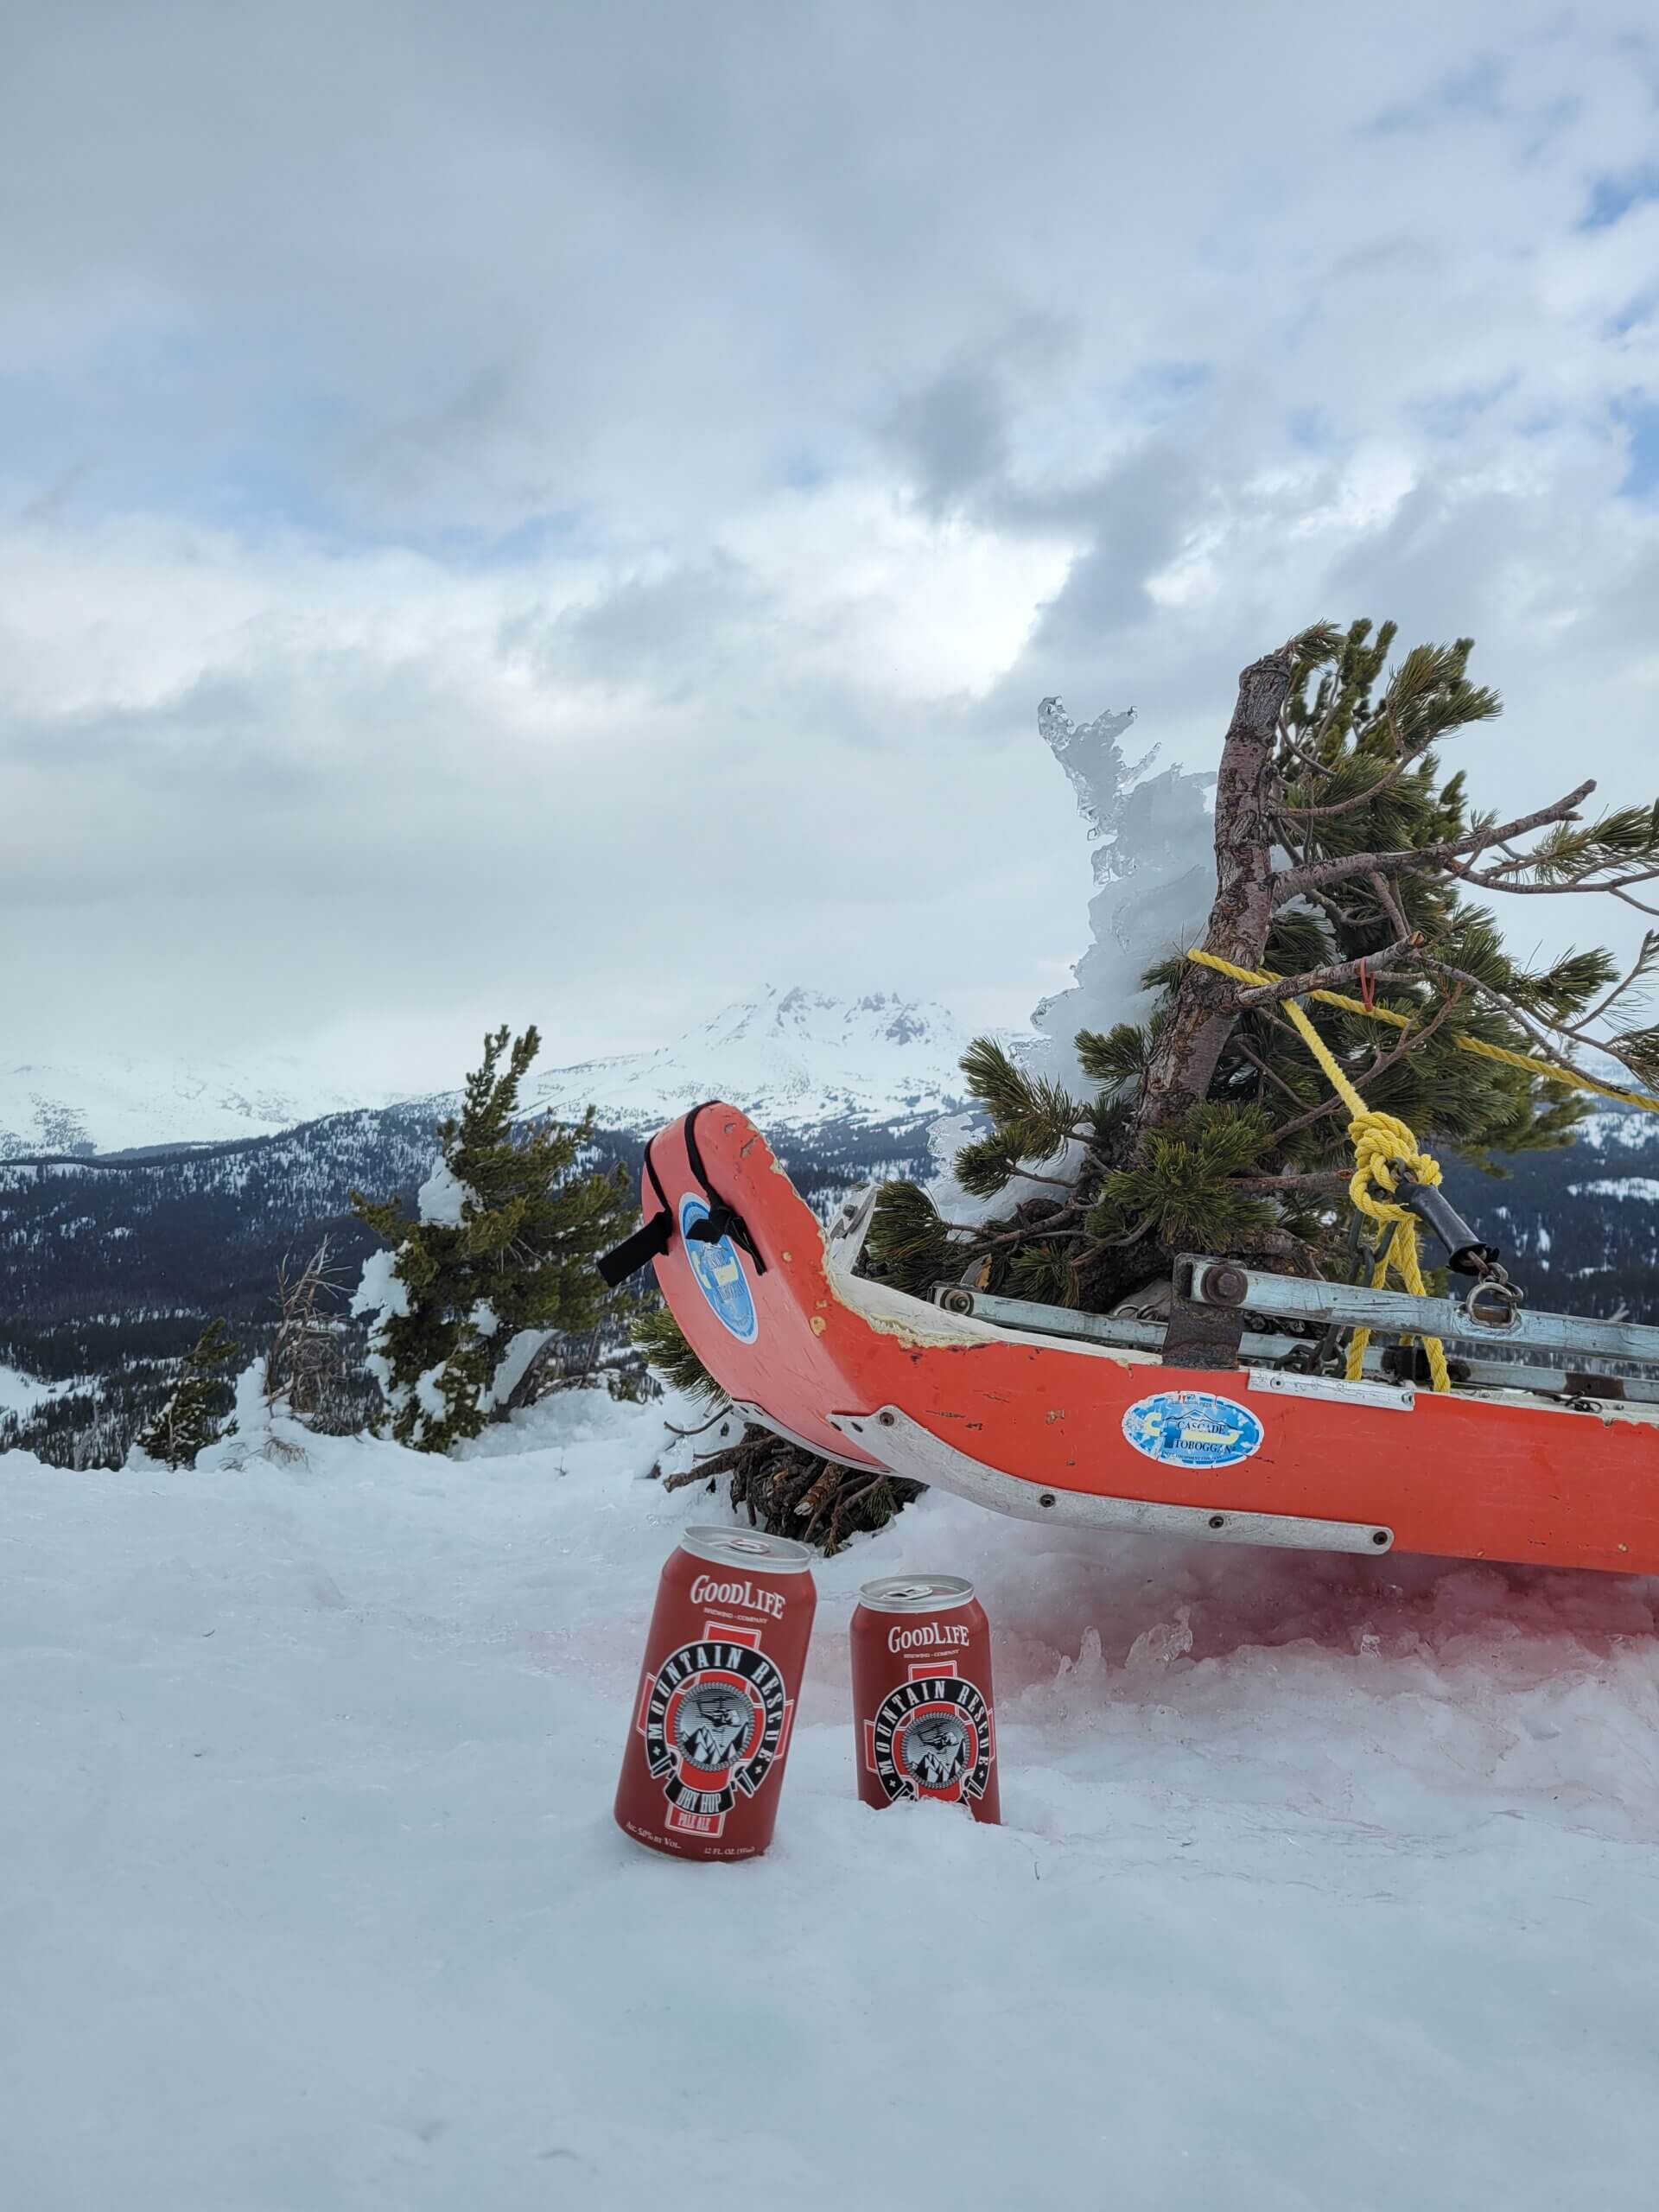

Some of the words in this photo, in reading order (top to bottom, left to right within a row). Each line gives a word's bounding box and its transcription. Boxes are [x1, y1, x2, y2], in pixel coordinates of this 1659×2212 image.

[1177, 1421, 1225, 1434] CASCADE
[1174, 1439, 1231, 1454] TOBOGGAN
[648, 1645, 743, 1740] MOUNTAIN
[750, 1661, 783, 1763] RESCUE
[875, 1680, 945, 1777] MOUNTAIN
[957, 1684, 990, 1766] RESCUE
[676, 1786, 700, 1811] DRY
[699, 1793, 721, 1814] HOP
[677, 1812, 695, 1829] PALE
[696, 1815, 711, 1831] ALE
